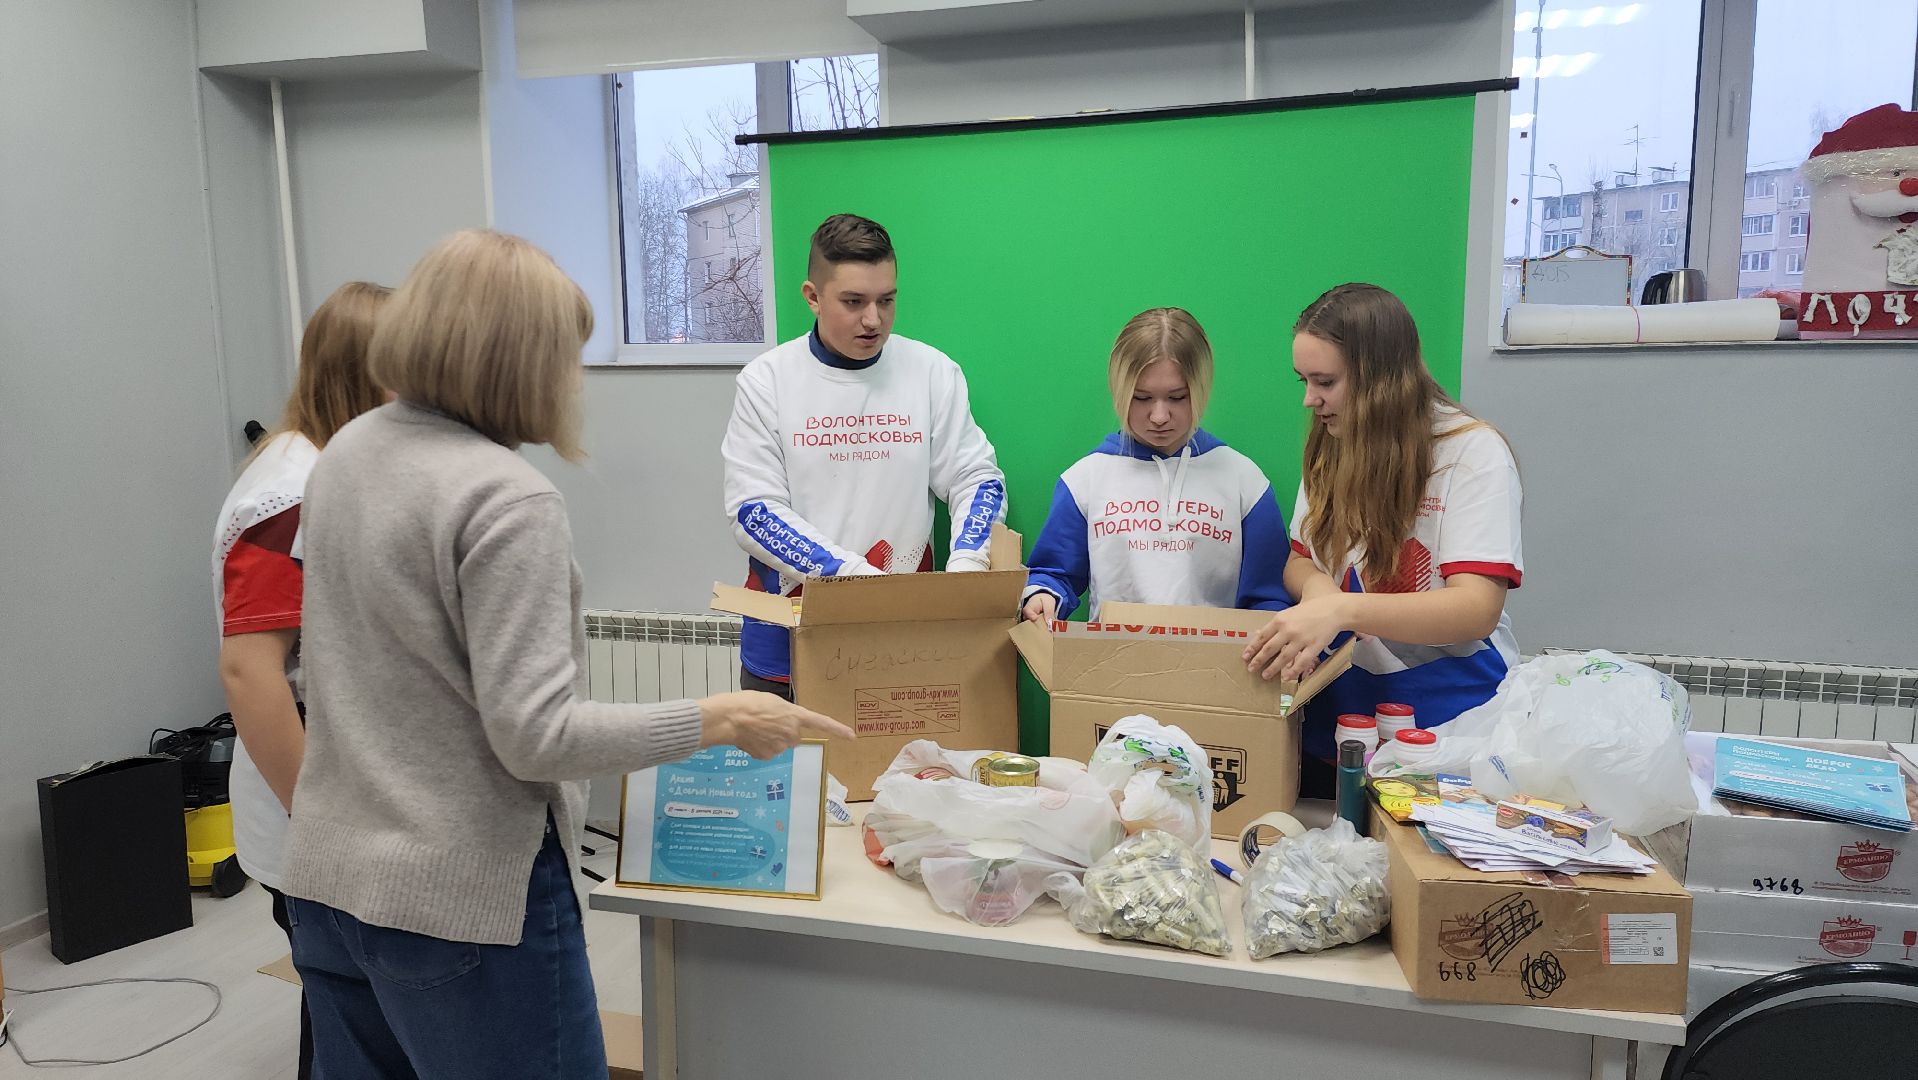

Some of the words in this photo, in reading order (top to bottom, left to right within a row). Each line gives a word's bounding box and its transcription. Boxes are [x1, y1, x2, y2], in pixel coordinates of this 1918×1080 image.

[1802, 293, 1918, 336] ПОЧ
[806, 414, 911, 430] ВОЛОНТЕРЫ
[793, 431, 923, 447] ПОДМОСКОВЬЯ
[829, 452, 850, 461] МЫ
[852, 450, 890, 462] РЯДОМ
[1105, 500, 1224, 521] ВОЛОТЕРЫ
[752, 505, 815, 555] ВОЛОНТЕРЫ
[744, 513, 824, 572] ПОДМОСКОВЬЯ
[1128, 540, 1149, 551] МЫ
[1153, 540, 1194, 552] РЯДОМ
[1752, 877, 1804, 895] 9768
[1440, 962, 1476, 981] 668
